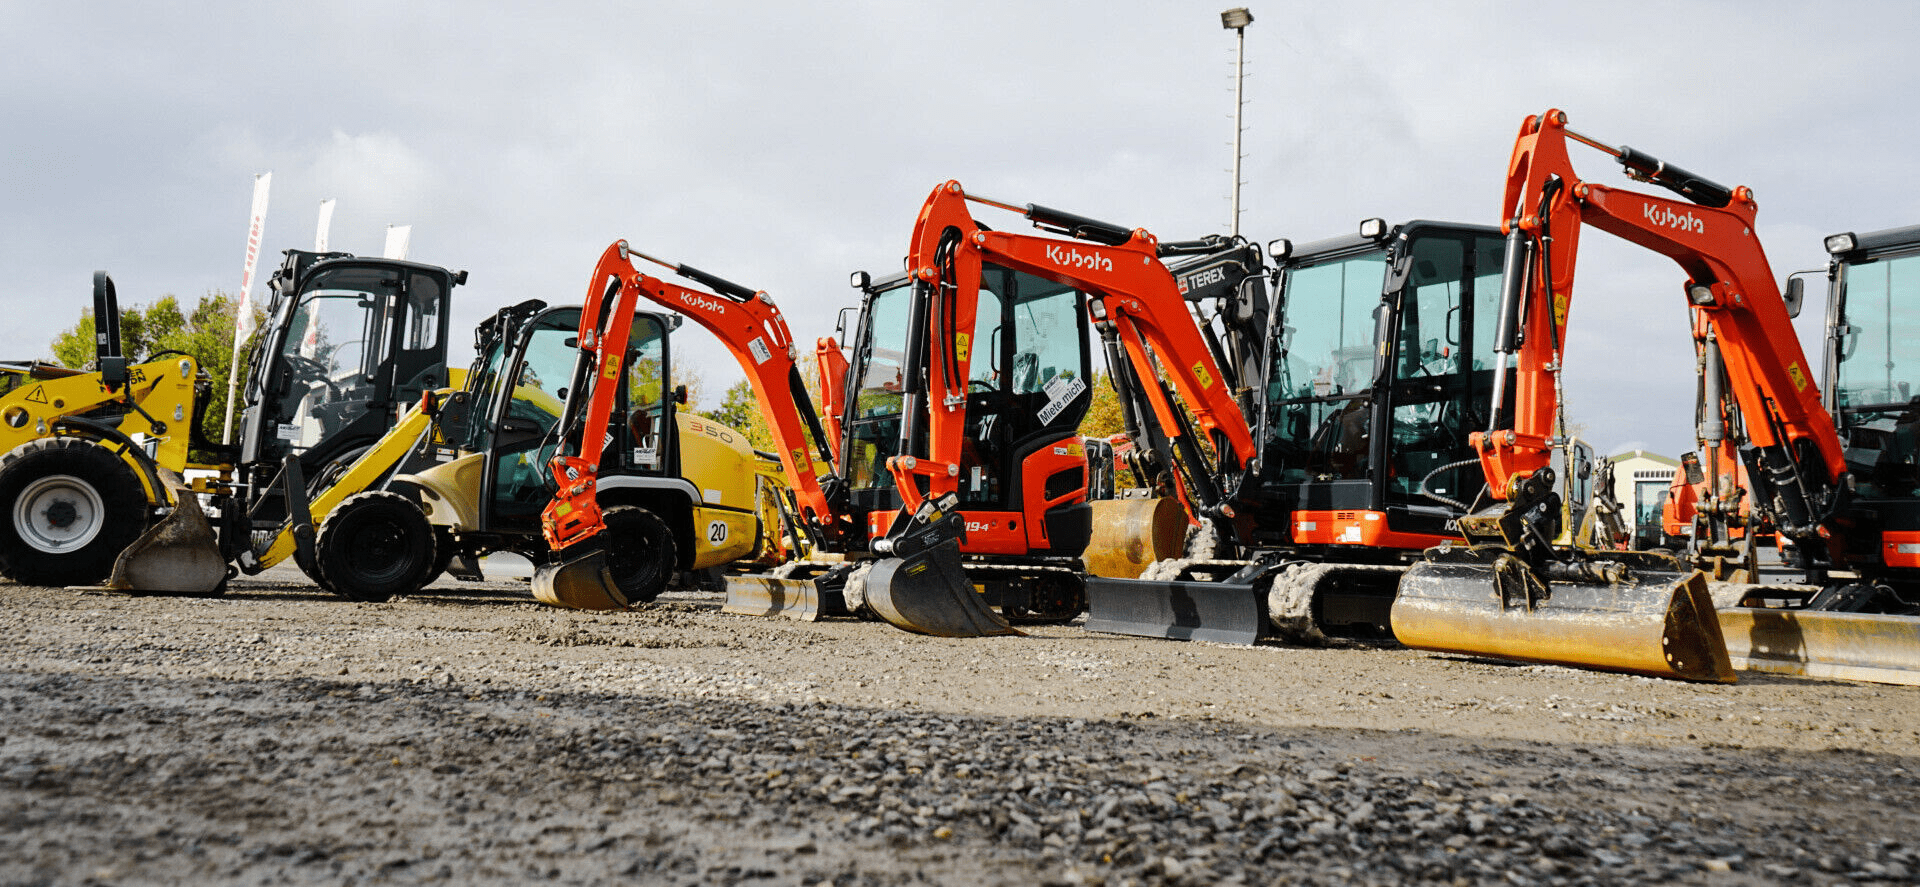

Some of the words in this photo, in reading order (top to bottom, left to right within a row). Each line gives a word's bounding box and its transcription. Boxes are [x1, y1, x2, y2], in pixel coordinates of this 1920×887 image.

[1644, 202, 1704, 234] Kubota
[1046, 244, 1113, 272] Kubota
[1188, 266, 1226, 290] TEREX
[680, 291, 725, 315] Kubota
[1039, 400, 1063, 424] Miete
[1062, 378, 1085, 405] mich!
[690, 420, 733, 444] 350
[710, 523, 726, 542] 20
[963, 521, 989, 532] 19-4
